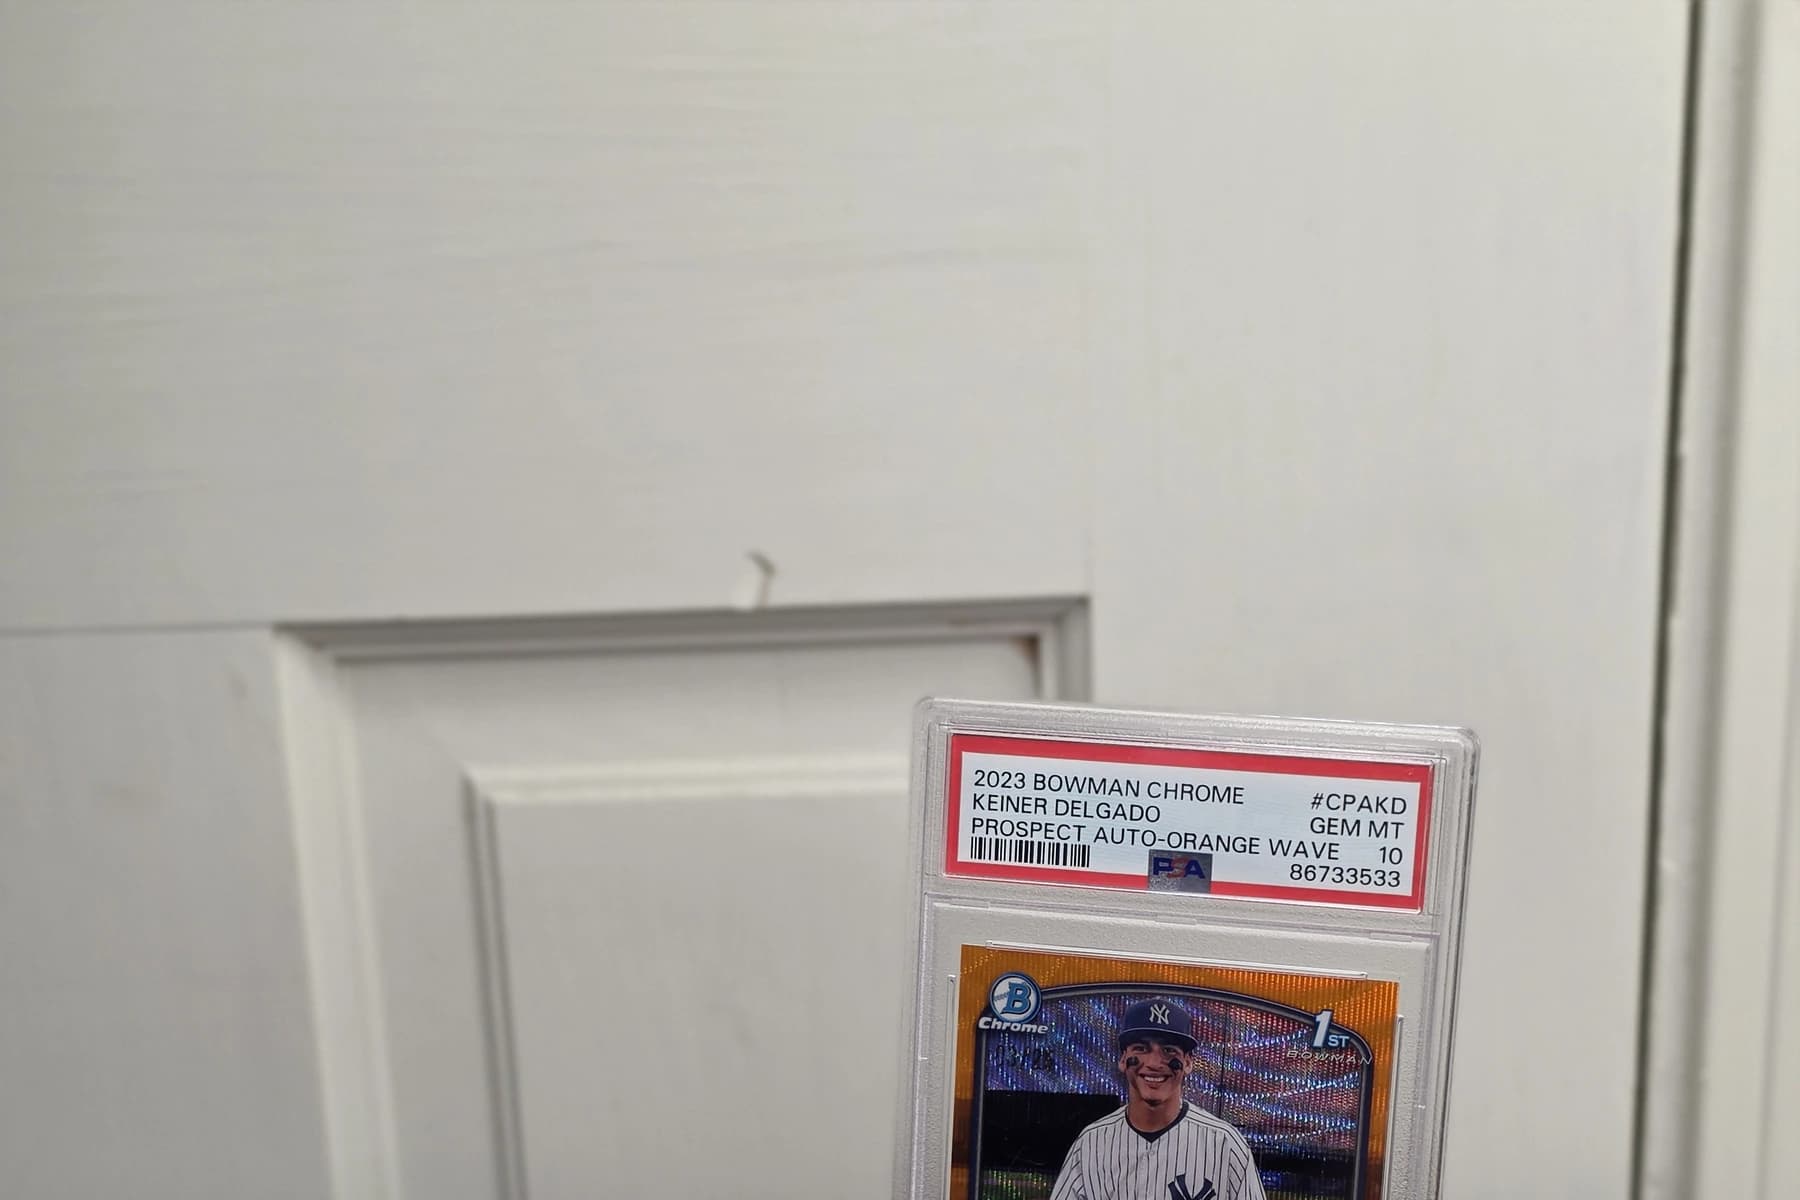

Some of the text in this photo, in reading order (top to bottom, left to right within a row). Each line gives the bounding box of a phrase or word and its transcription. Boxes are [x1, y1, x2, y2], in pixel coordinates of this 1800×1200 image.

[974, 769, 1245, 804] 2023 BOWMAN CHROME
[972, 793, 1161, 822] KEINER DELGADO
[1311, 792, 1407, 814] #CPAKD
[972, 817, 1340, 860] PROSPECT AUTO-ORANGE WAVE
[1310, 816, 1405, 840] GEM MT
[1379, 846, 1403, 865] 10
[1153, 857, 1205, 879] PSA
[1289, 864, 1400, 887] 86733533
[978, 1016, 1049, 1034] Chrome
[1286, 1050, 1372, 1065] BOWMAN
